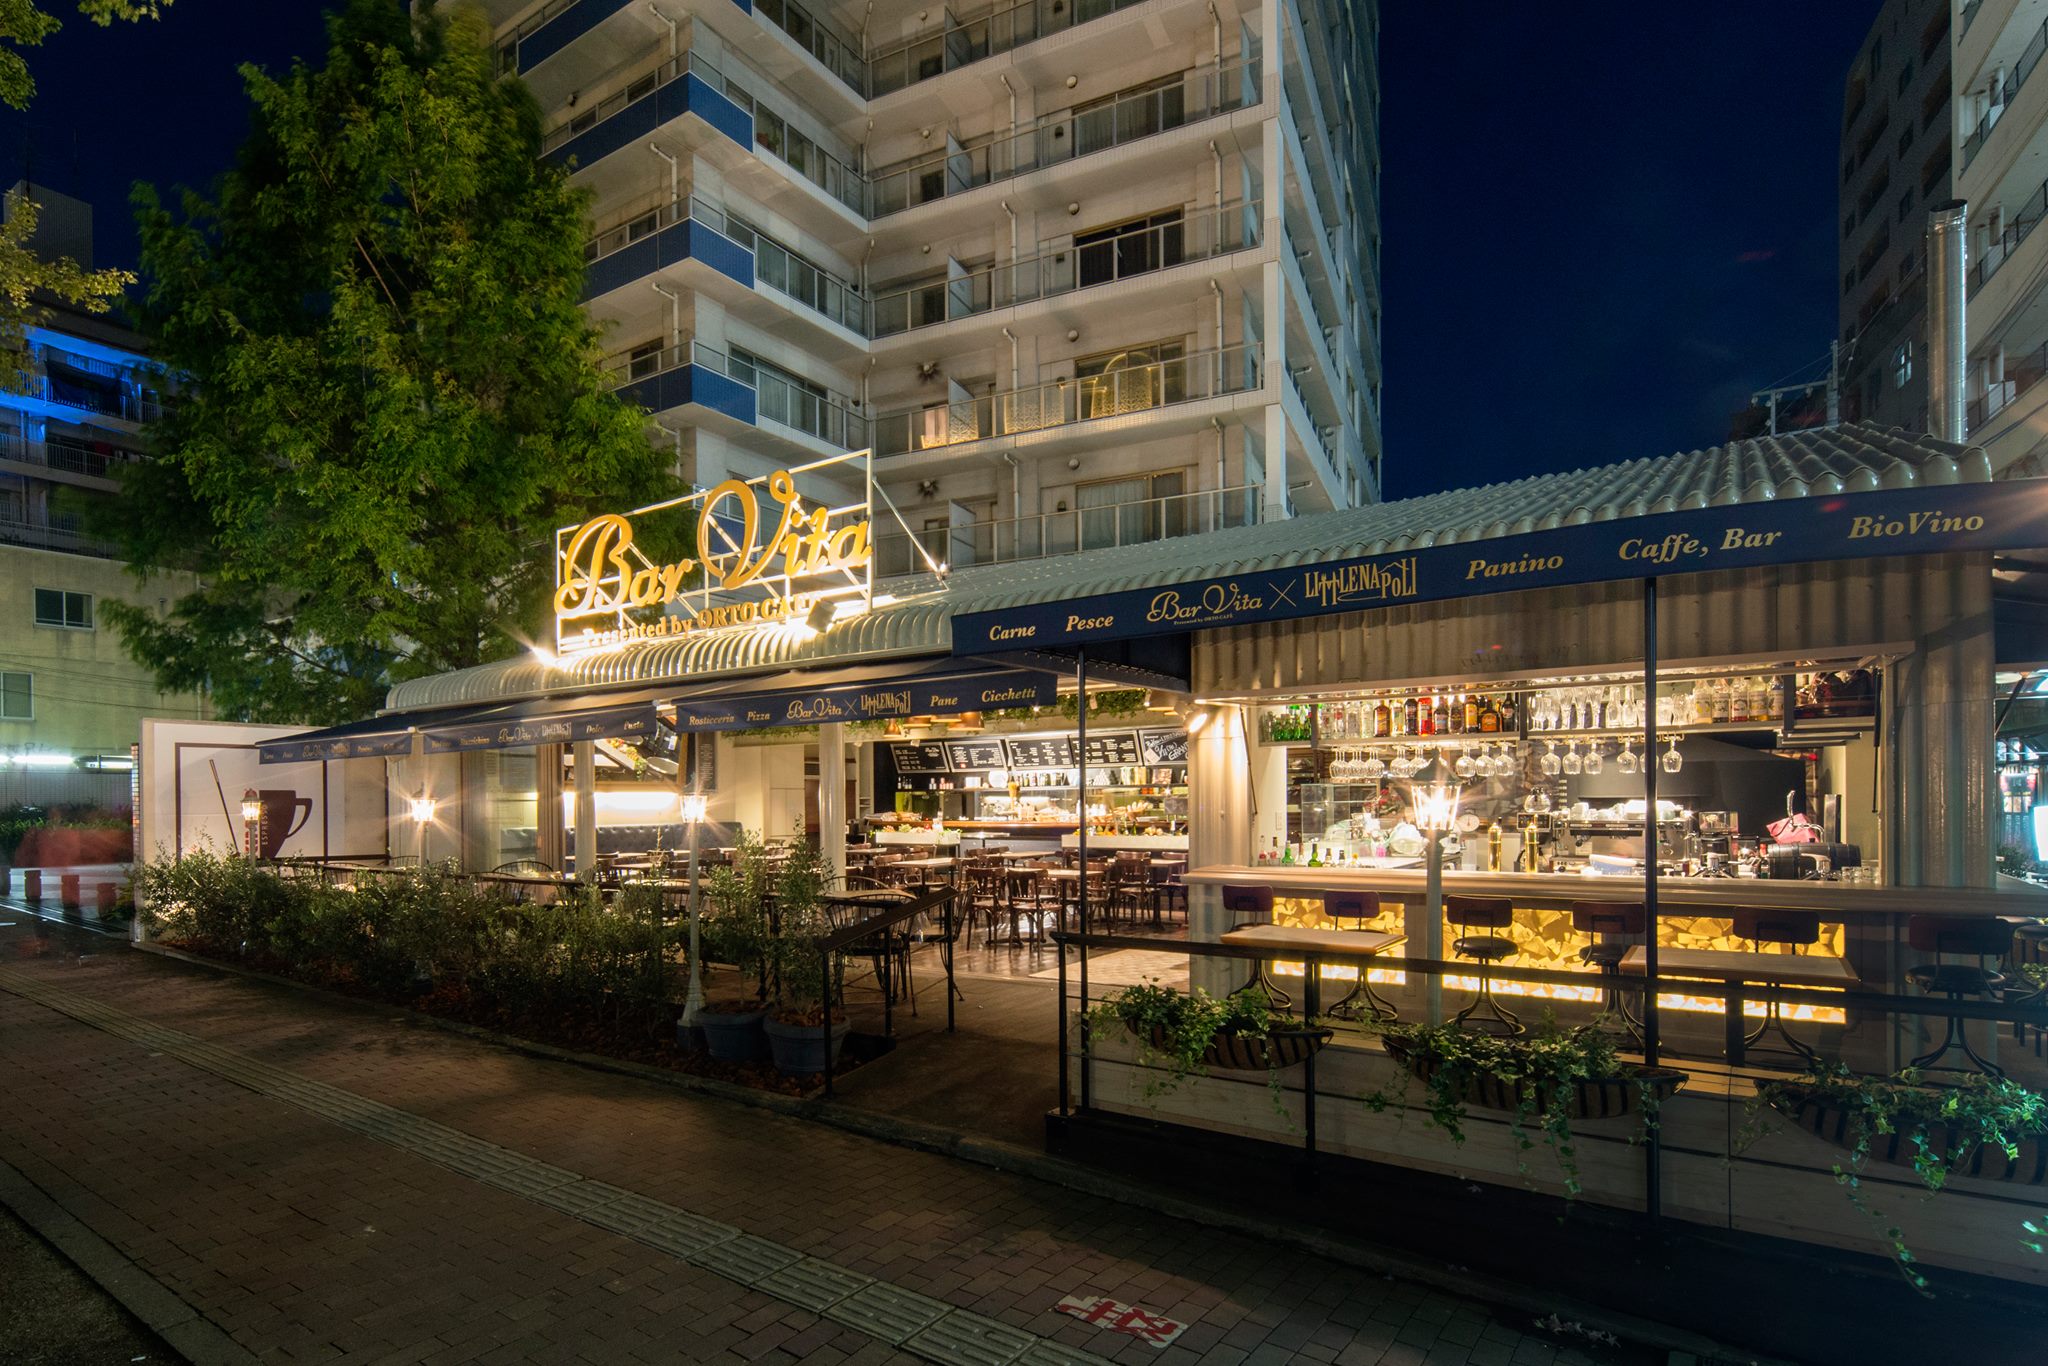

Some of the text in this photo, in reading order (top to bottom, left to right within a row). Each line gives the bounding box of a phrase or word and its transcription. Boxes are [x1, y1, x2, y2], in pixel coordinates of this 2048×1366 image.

[554, 470, 873, 618] Bar Vita
[1720, 528, 1782, 550] Bar
[1465, 553, 1564, 579] Panino
[1147, 591, 1202, 622] Bar
[1203, 583, 1263, 614] Vita
[670, 614, 692, 639] by
[697, 601, 757, 630] ORTO
[989, 625, 1036, 641] Carne
[1065, 615, 1114, 632] Pesce
[688, 713, 735, 726] Rosticceria
[747, 710, 771, 722] Pizza
[930, 695, 959, 707] Pane
[981, 686, 1037, 703] Cicchetti
